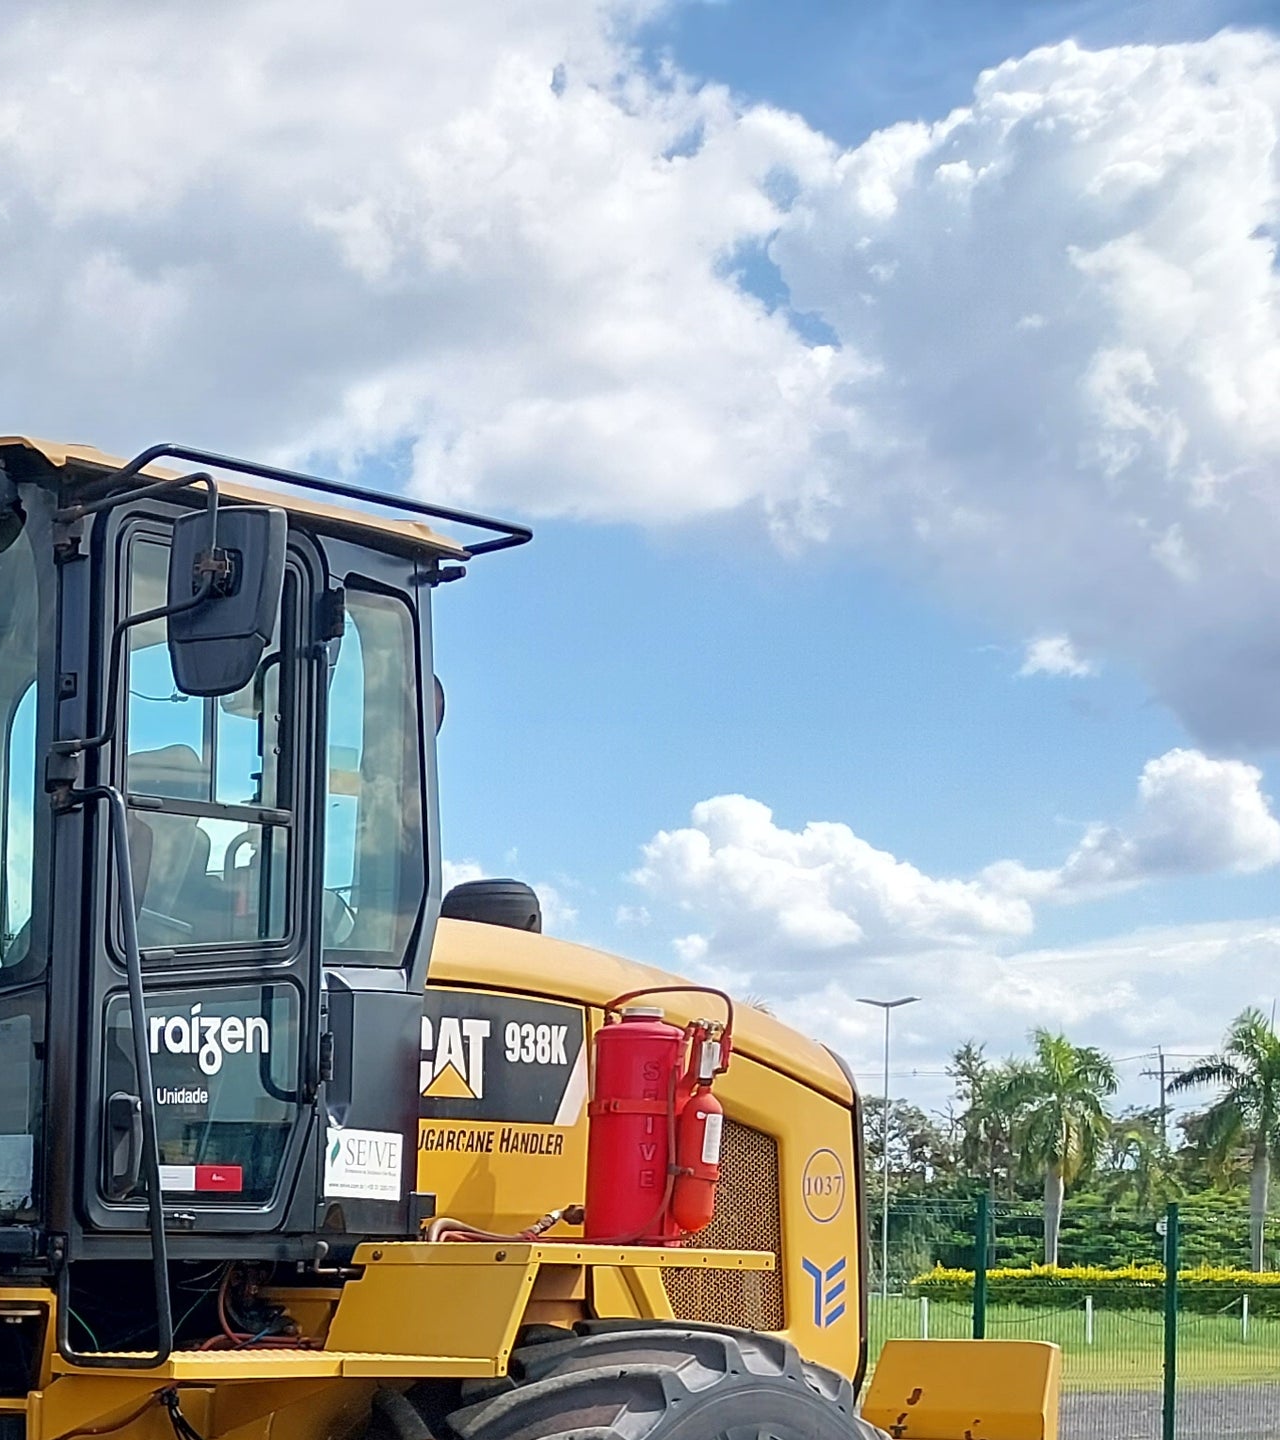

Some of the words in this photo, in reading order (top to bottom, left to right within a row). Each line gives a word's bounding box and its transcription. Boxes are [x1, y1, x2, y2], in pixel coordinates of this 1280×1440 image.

[149, 1002, 270, 1076] raízen
[504, 1021, 568, 1065] 938K
[156, 1087, 209, 1105] Unidade
[344, 1137, 397, 1169] SEIVE
[417, 1128, 495, 1153] UGARCANE
[804, 1174, 842, 1197] 1037
